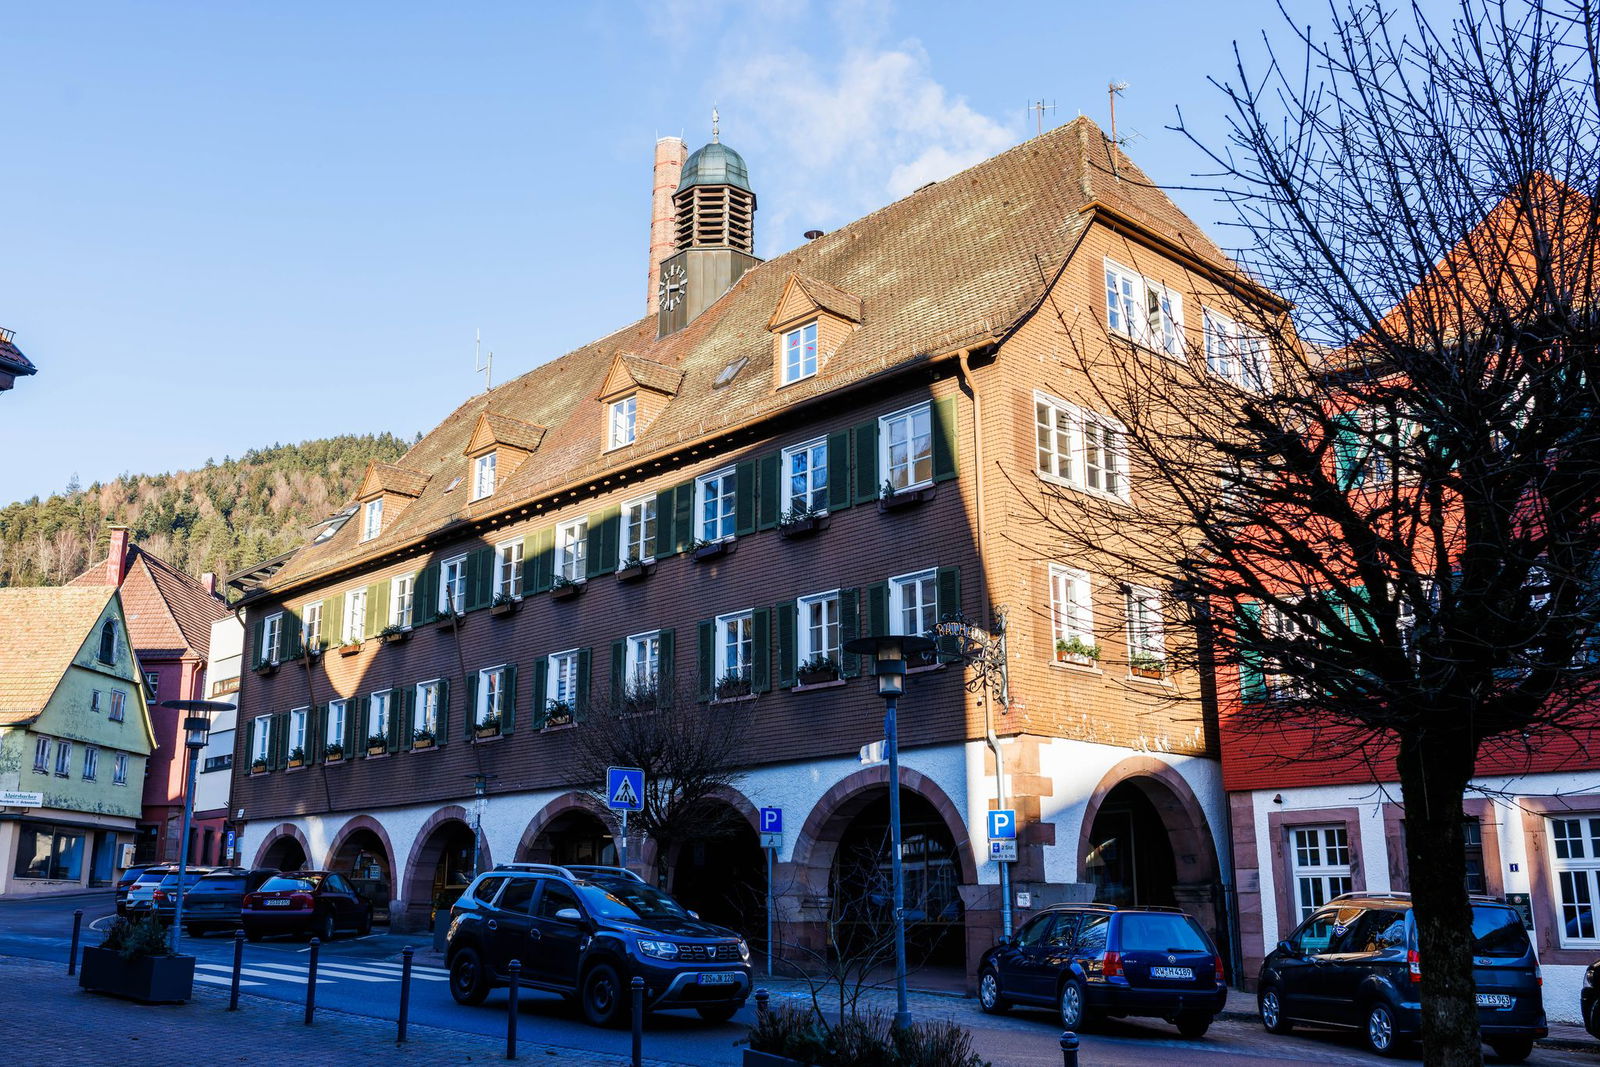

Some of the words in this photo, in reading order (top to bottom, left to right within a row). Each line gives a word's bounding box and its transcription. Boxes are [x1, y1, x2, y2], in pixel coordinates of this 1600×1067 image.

[765, 811, 777, 829] P
[994, 814, 1009, 835] P
[228, 834, 233, 846] P
[1155, 967, 1165, 975] RW
[1175, 967, 1191, 976] 4189
[1488, 995, 1496, 1004] ES
[1497, 995, 1509, 1005] 963
